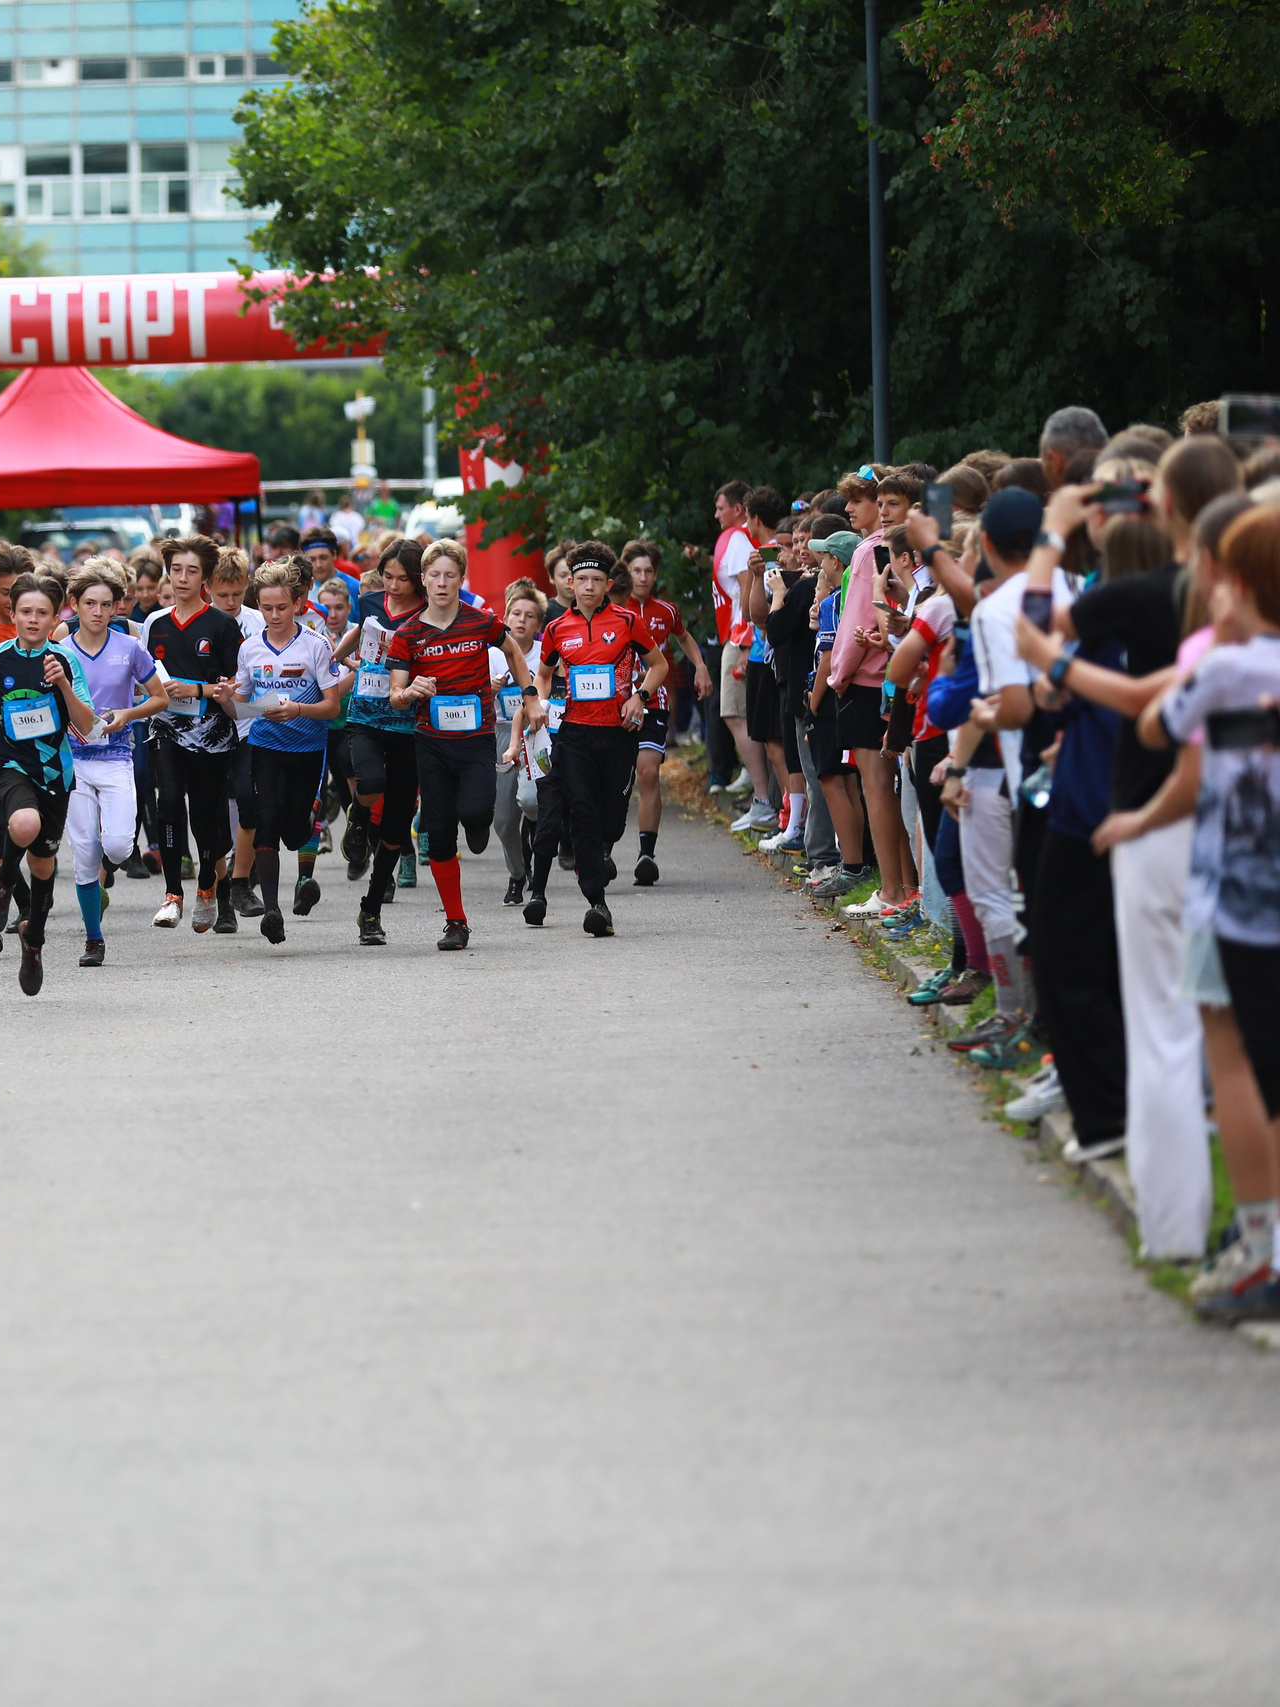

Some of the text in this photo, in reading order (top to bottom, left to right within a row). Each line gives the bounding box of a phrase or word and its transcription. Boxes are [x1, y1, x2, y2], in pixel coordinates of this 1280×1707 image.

[362, 678, 381, 687] 311.1
[581, 682, 602, 690] 321.1
[444, 710, 467, 719] 300.1
[19, 714, 44, 725] 306.1
